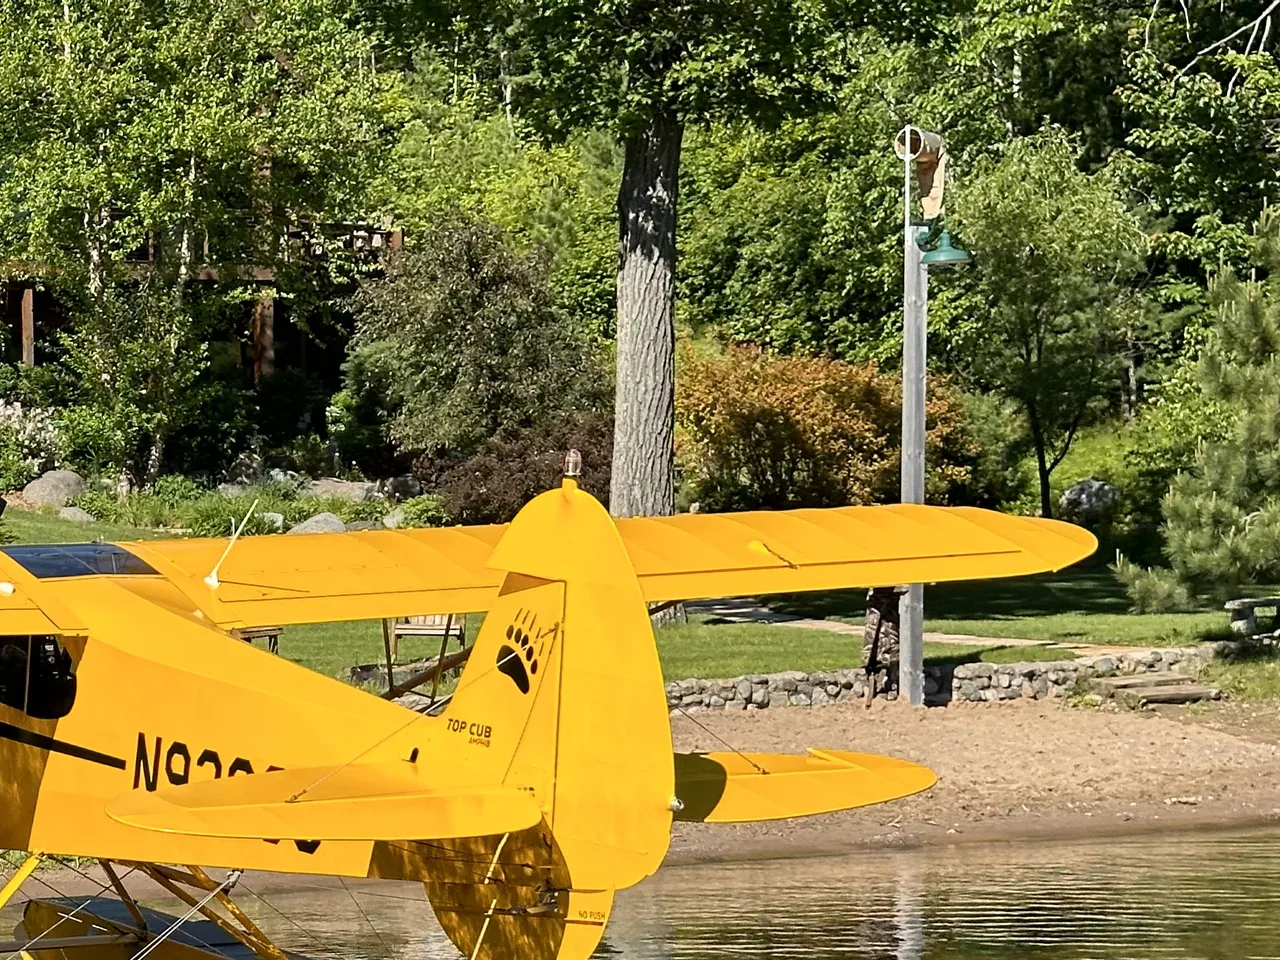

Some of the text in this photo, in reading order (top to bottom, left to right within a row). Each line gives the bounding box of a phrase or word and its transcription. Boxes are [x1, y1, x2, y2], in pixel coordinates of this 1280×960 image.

[446, 718, 492, 738] TOP CUB
[578, 910, 605, 920] NO PUSH
